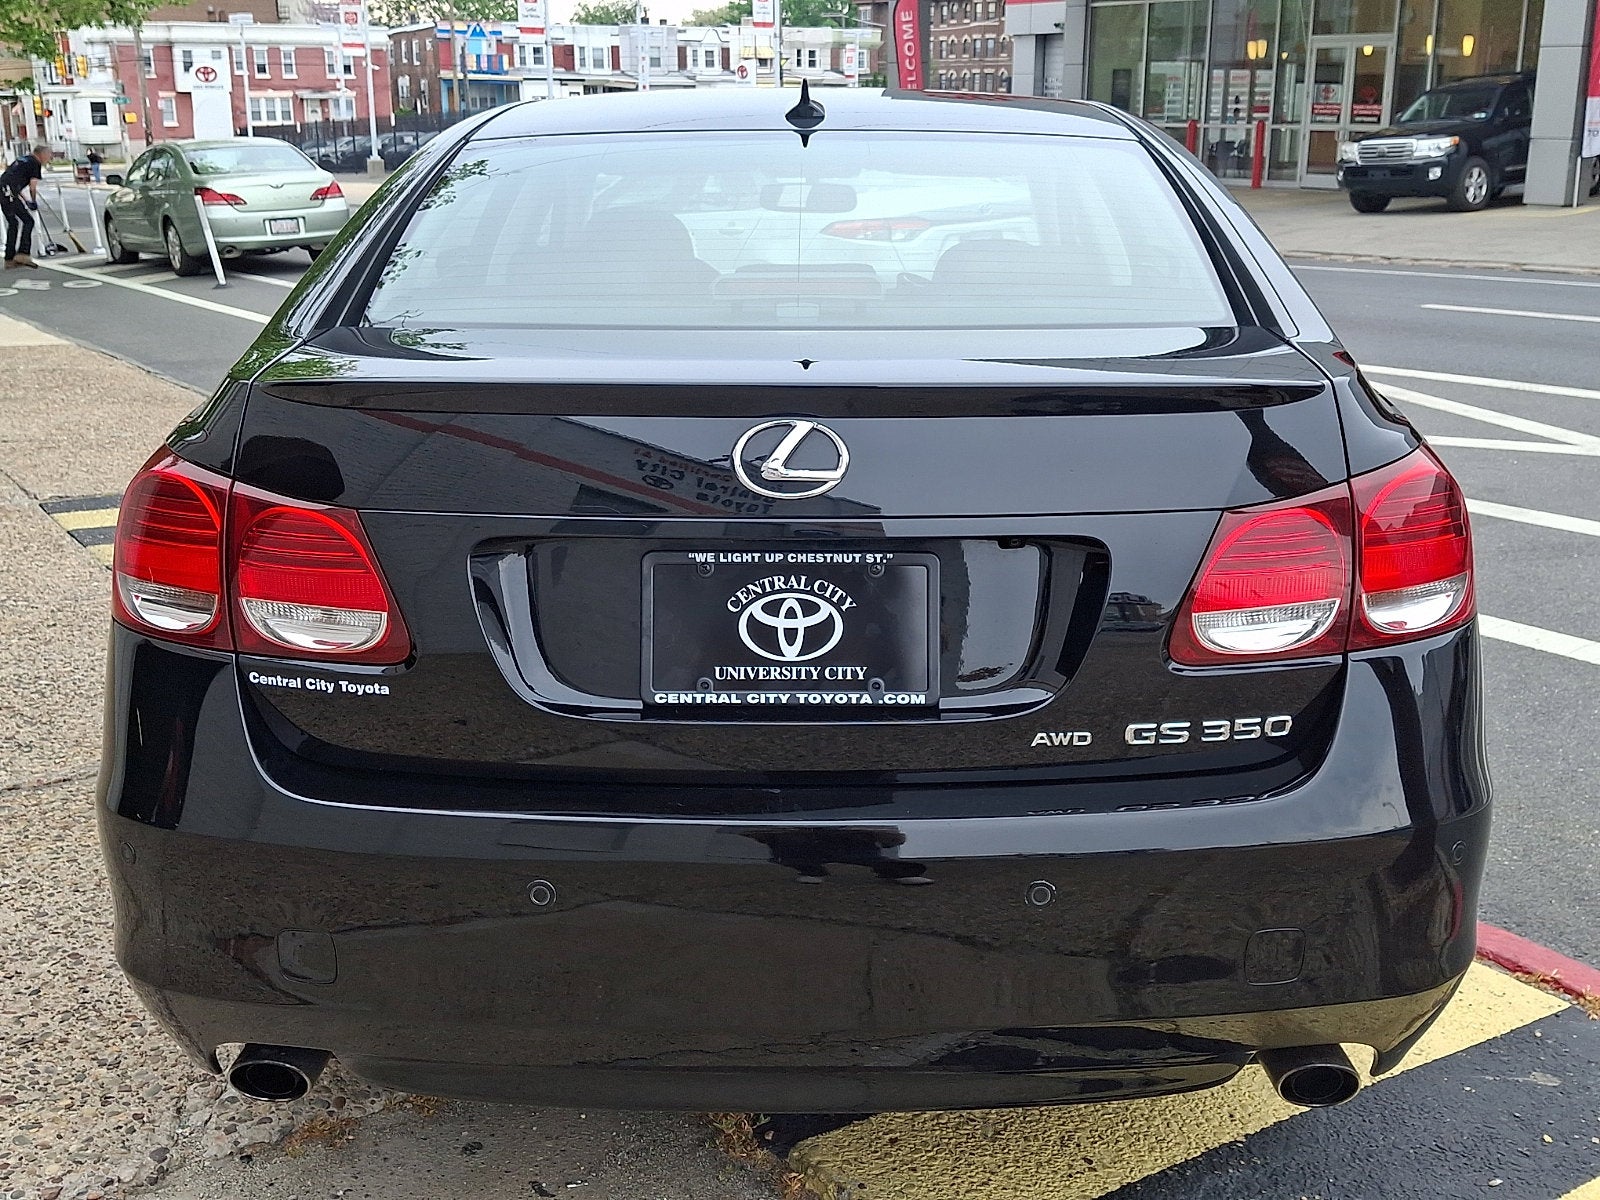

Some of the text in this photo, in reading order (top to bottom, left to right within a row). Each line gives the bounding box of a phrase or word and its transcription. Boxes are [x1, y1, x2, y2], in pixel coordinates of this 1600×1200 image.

[901, 10, 917, 90] ELCOME
[719, 552, 761, 563] LIGHT
[765, 552, 784, 563] UP
[788, 552, 861, 564] CHESTNUT
[726, 575, 858, 613] CENTRAL CITY
[249, 671, 390, 696] Central City Toyota
[714, 666, 868, 681] UNIVERSITY CITY
[654, 693, 926, 705] CENTRAL CITY TOYOTA .COM
[1030, 731, 1093, 747] AWD
[1124, 715, 1293, 745] GS 350
